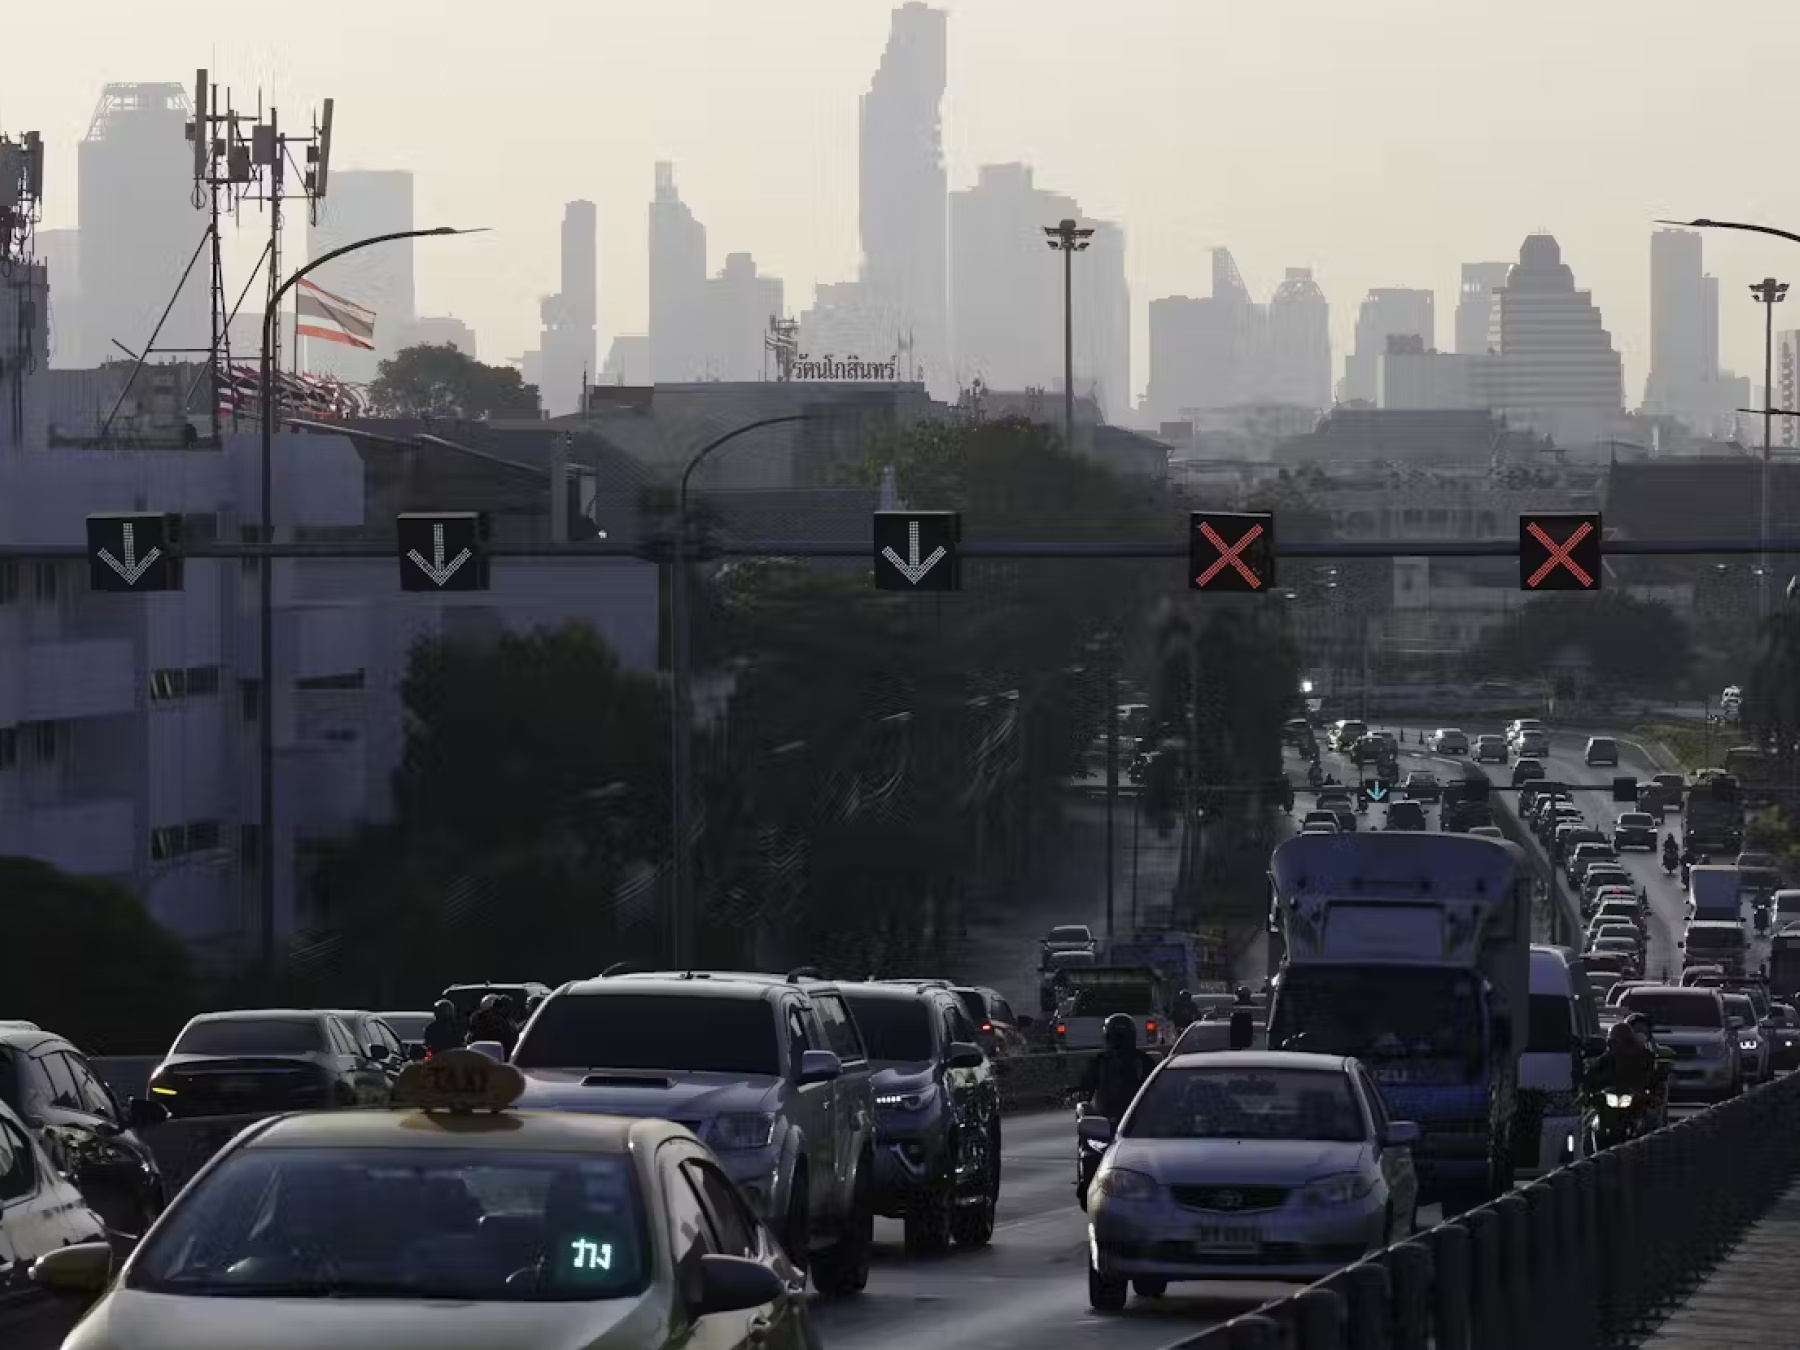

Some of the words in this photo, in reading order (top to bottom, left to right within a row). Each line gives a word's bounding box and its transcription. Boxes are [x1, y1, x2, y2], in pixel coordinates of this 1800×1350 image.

[792, 353, 896, 380] รัตนโกสินทร์
[571, 1238, 612, 1270] ว่าง
